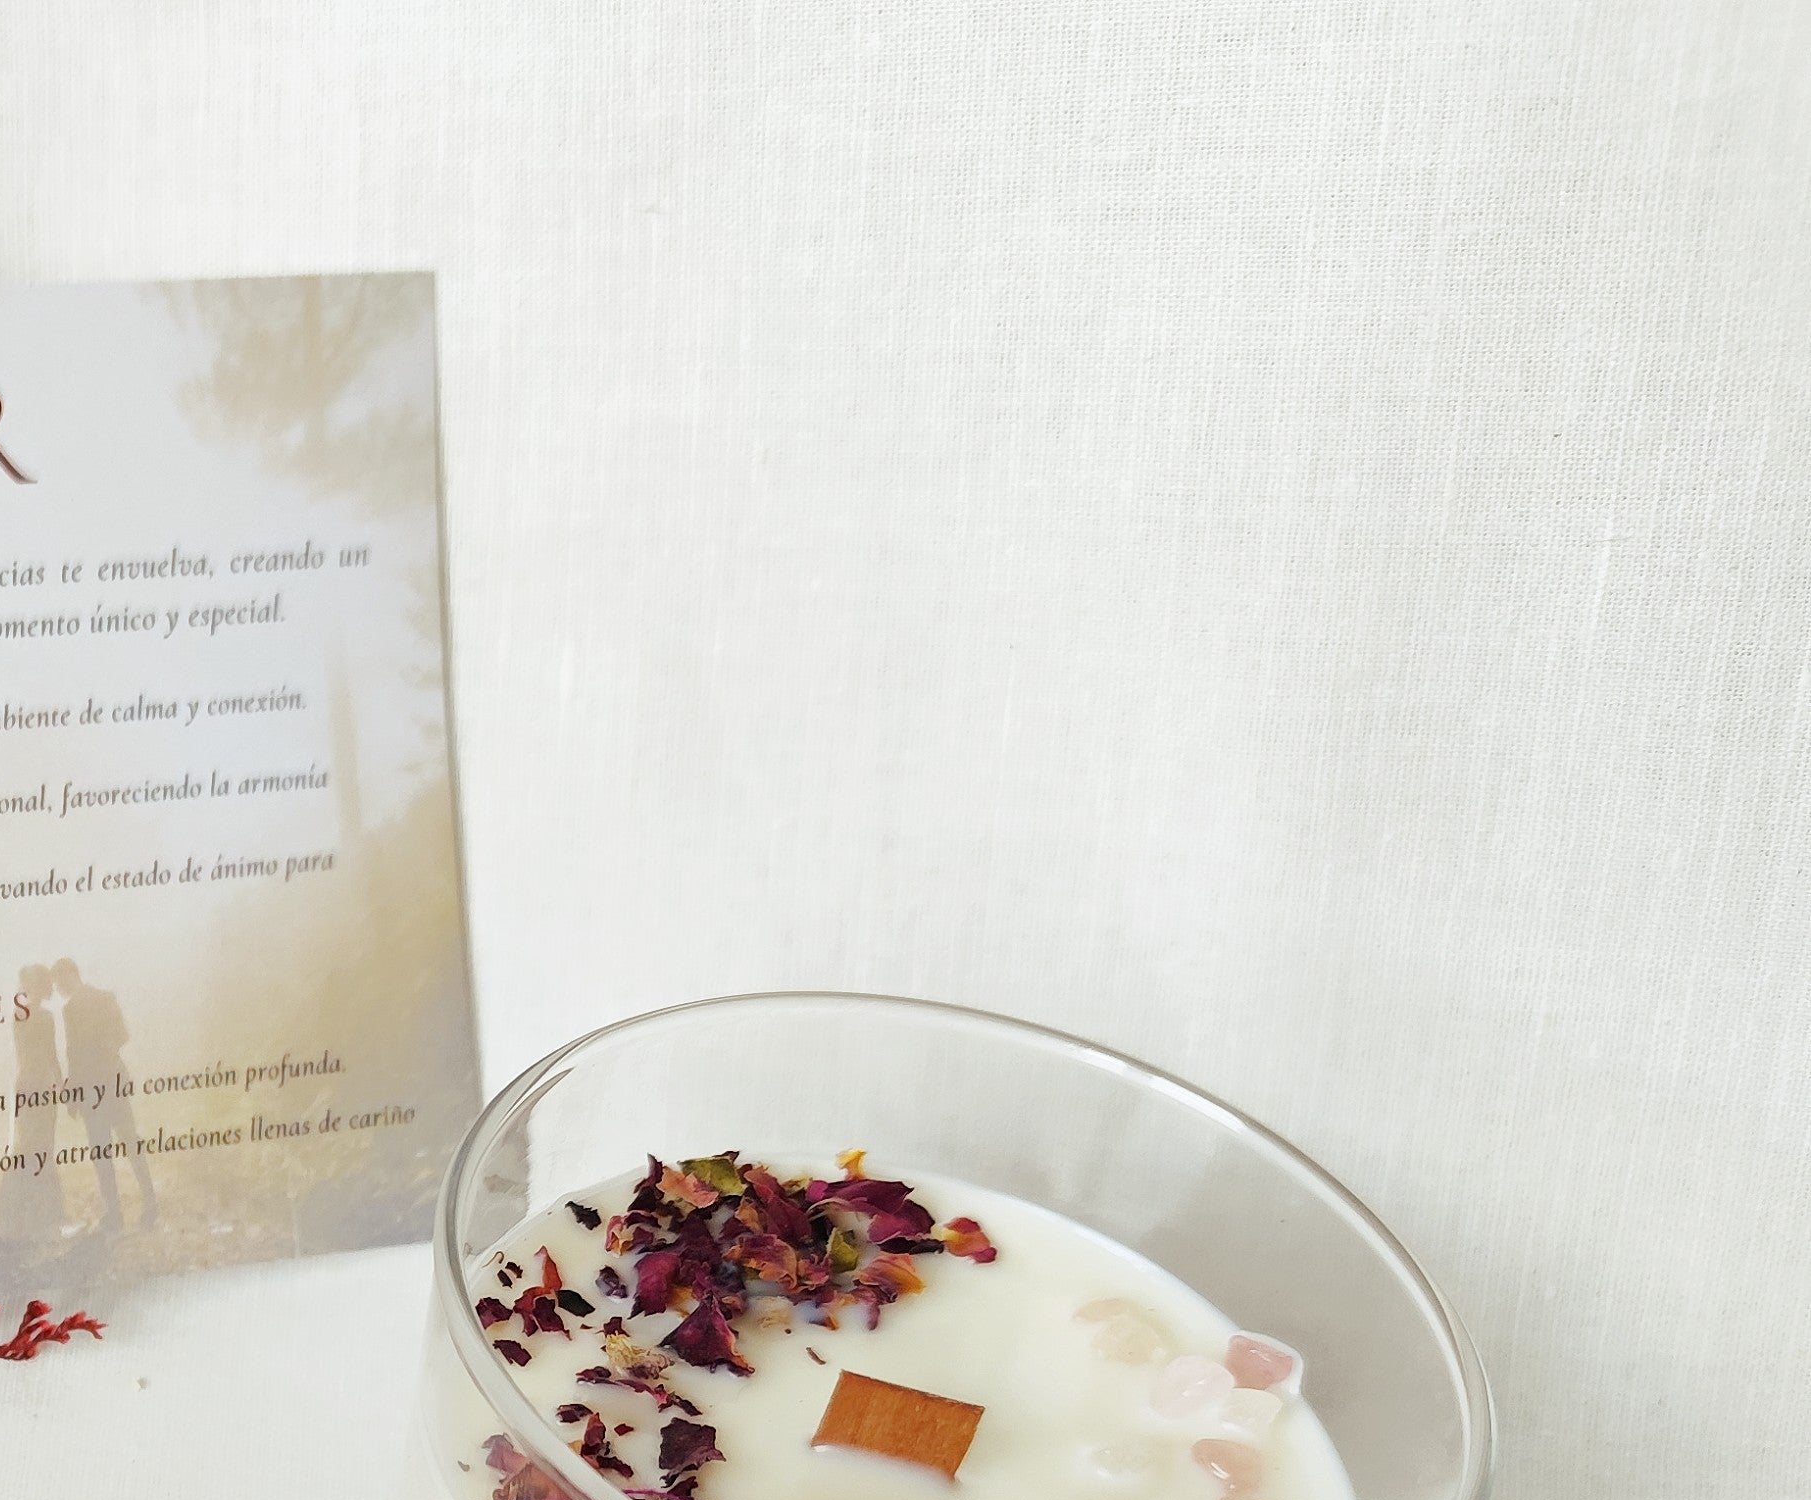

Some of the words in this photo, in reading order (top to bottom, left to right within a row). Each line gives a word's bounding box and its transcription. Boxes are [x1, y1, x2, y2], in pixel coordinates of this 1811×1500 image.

[61, 562, 83, 585] te
[97, 544, 215, 582] envuelva,
[229, 538, 326, 575] creando
[338, 545, 372, 569] un
[89, 603, 157, 634] único
[163, 609, 180, 640] y
[187, 592, 286, 637] especial.
[78, 697, 104, 726] de
[111, 693, 179, 724] calma
[184, 699, 200, 728] y
[206, 684, 307, 717] conexión.
[58, 772, 203, 819] favoreciendo
[210, 769, 230, 798] la
[237, 762, 329, 796] armonía
[74, 864, 94, 893] el
[101, 859, 172, 891] estado
[178, 856, 203, 884] de
[210, 853, 279, 882] ánimo
[284, 853, 335, 884] para
[14, 1078, 85, 1118] pasión
[91, 1084, 106, 1111] y
[115, 1072, 135, 1099] la
[142, 1060, 237, 1096] conexión
[244, 1049, 347, 1093] profunda.
[33, 1151, 48, 1177] y
[55, 1141, 128, 1166] atraen
[135, 1126, 242, 1156] relaciones
[250, 1114, 311, 1143] llenas
[317, 1108, 342, 1135] de
[348, 1105, 416, 1131] cariño
